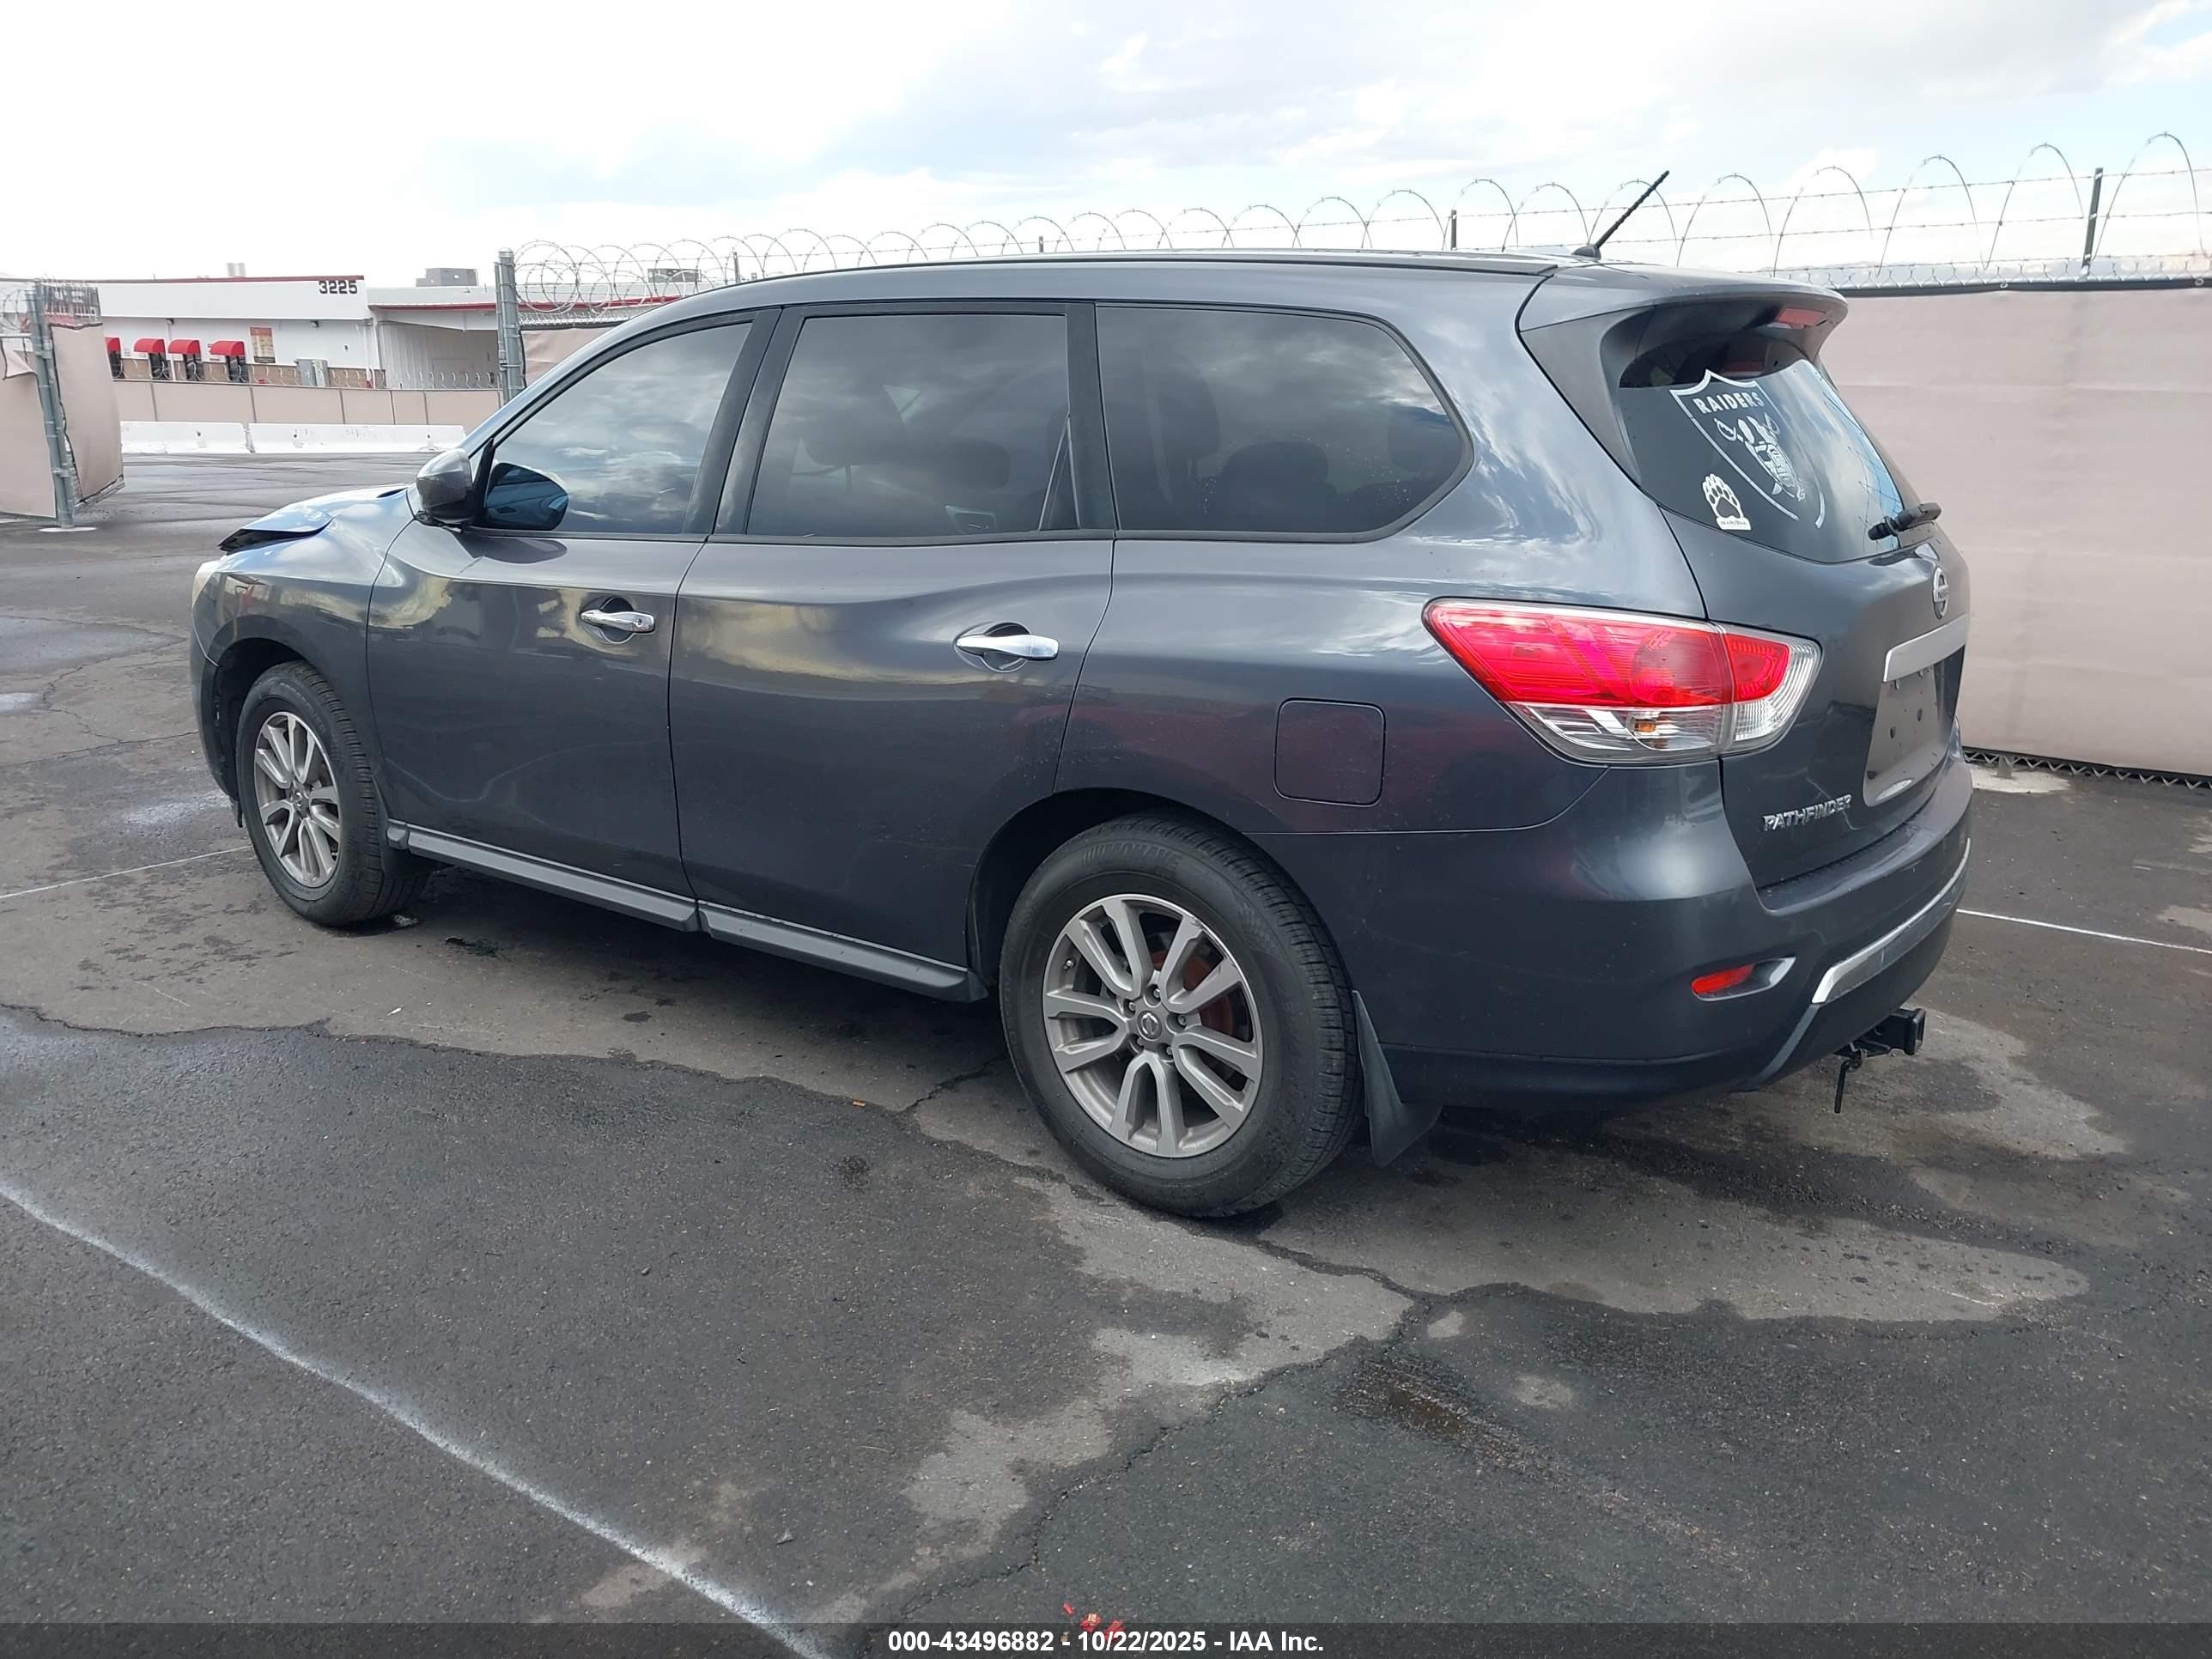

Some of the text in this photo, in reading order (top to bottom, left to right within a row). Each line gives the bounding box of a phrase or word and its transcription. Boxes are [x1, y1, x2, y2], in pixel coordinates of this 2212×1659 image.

[319, 280, 357, 295] 3225
[1692, 392, 1765, 414] RAIDERS
[1762, 794, 1852, 831] PATHFINDER
